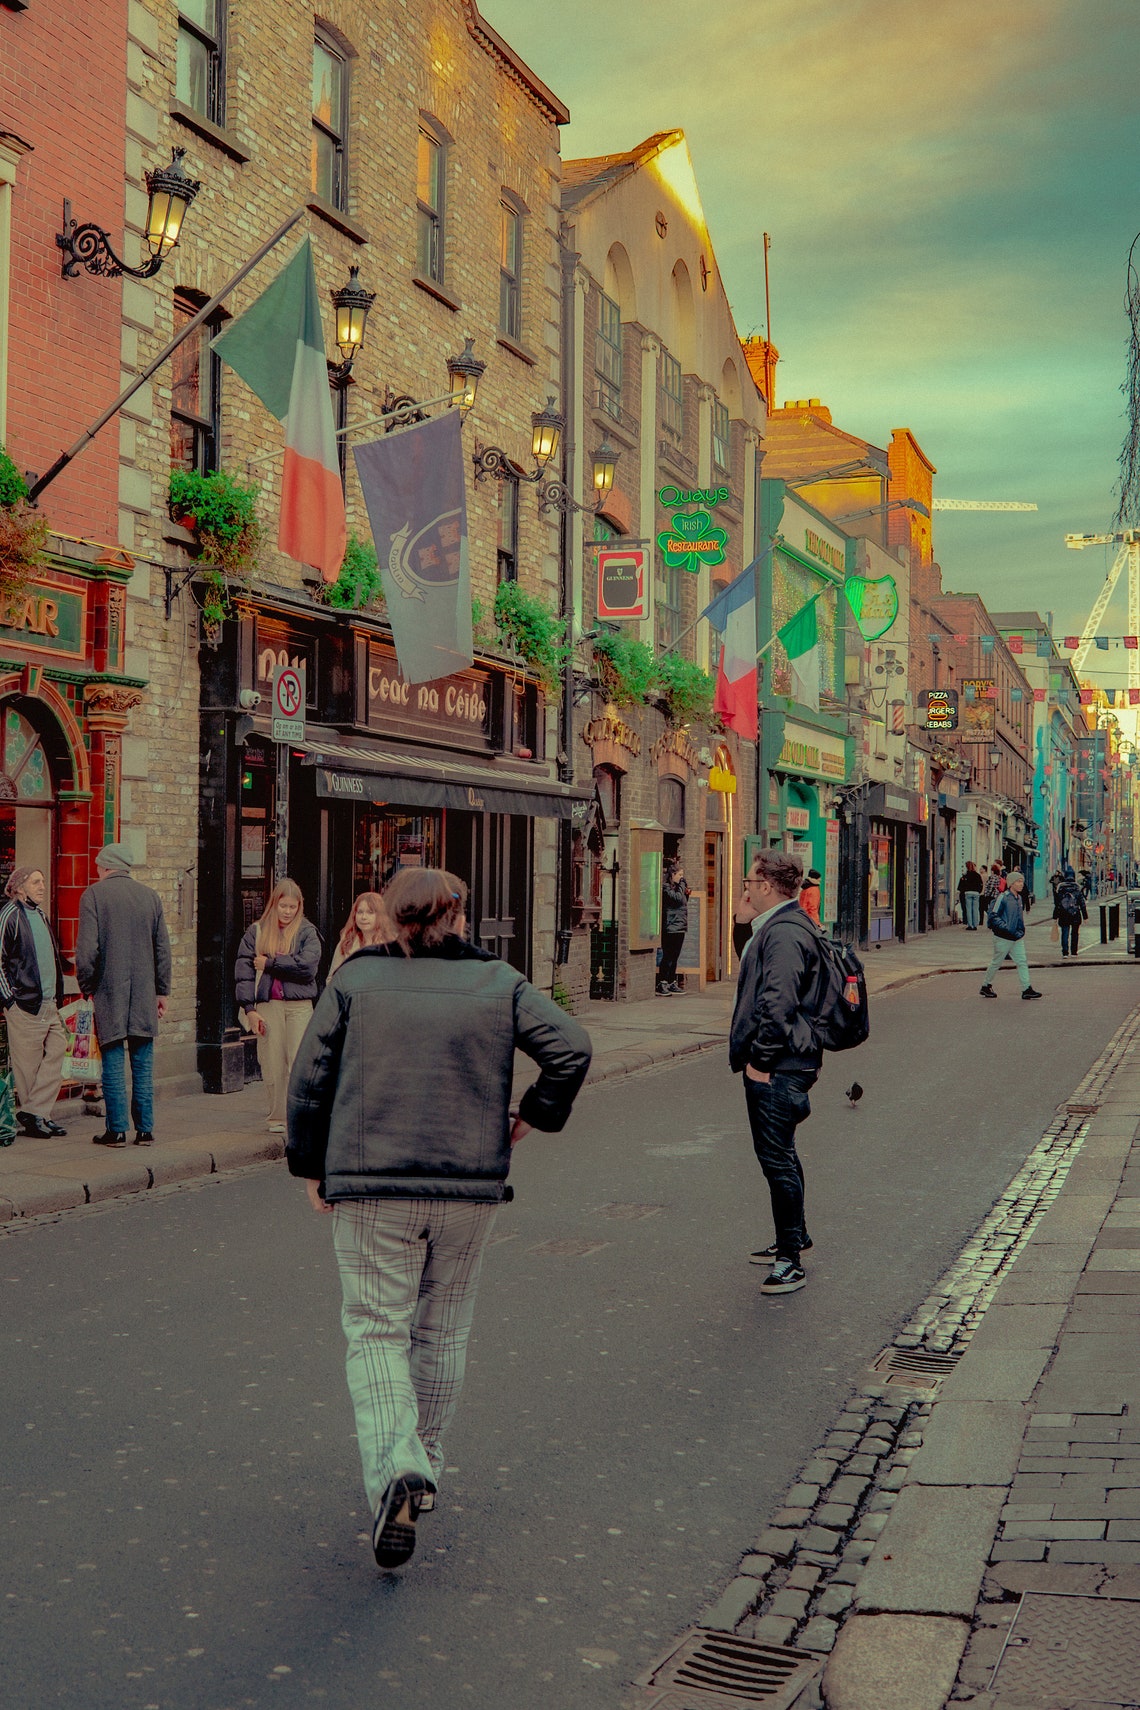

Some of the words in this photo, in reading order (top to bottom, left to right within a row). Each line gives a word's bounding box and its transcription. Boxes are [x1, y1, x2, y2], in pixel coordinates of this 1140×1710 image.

[659, 485, 729, 508] Quays
[667, 538, 720, 553] Restaurant
[417, 686, 440, 713] na
[928, 691, 949, 699] PIZZA
[927, 707, 956, 715] URGERS
[331, 772, 364, 794] GUINNESS
